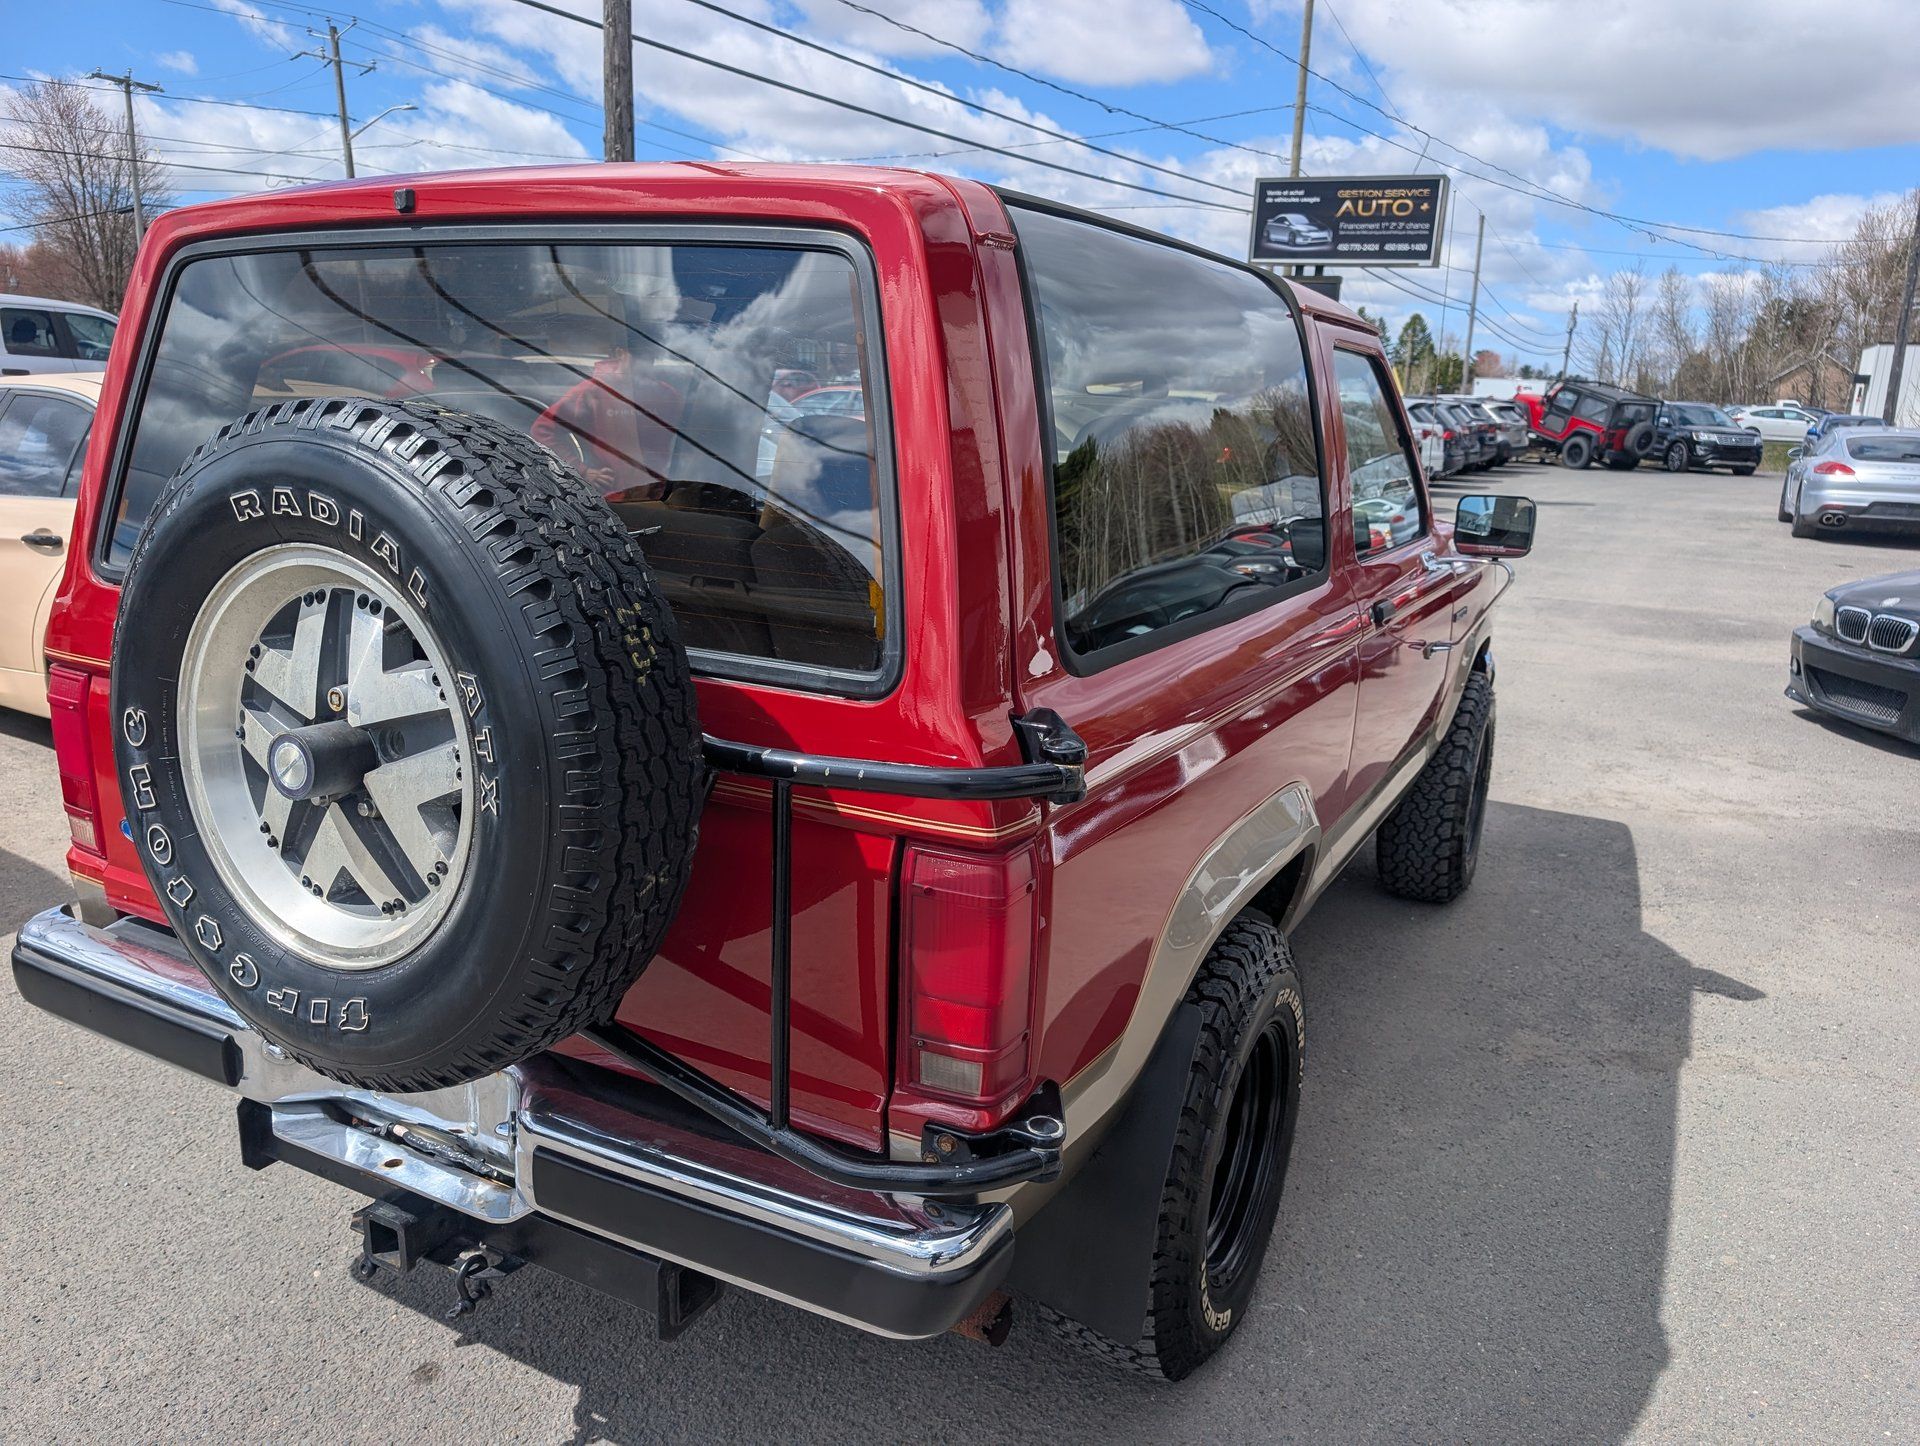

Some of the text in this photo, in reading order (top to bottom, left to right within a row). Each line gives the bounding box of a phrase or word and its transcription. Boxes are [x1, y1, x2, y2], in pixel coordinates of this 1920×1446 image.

[1335, 199, 1414, 219] AUTO
[1337, 188, 1431, 198] GESTION SERVICE
[230, 487, 429, 609] RADIAL
[457, 671, 499, 817] ATX
[1274, 987, 1305, 1050] GRABBER
